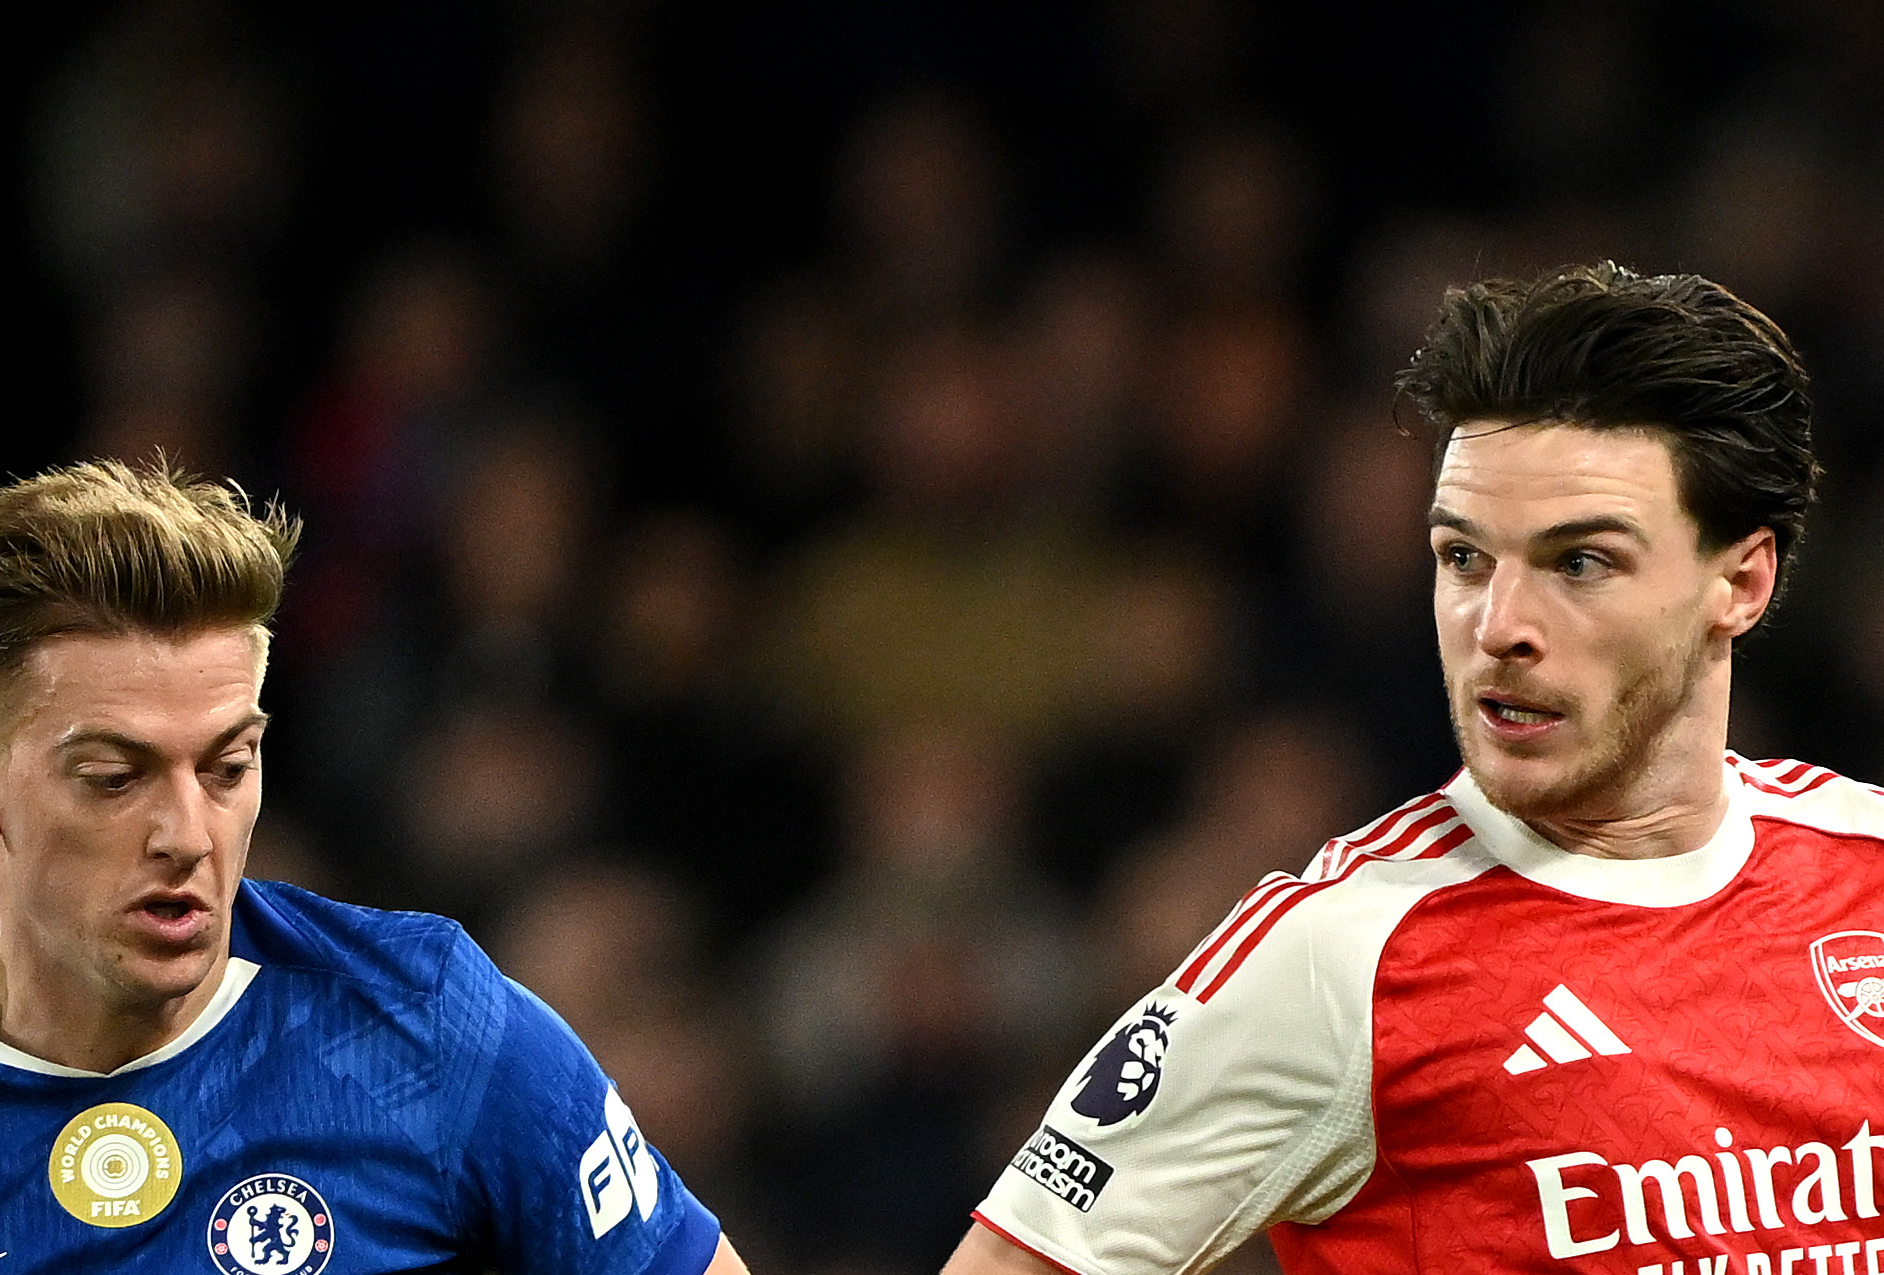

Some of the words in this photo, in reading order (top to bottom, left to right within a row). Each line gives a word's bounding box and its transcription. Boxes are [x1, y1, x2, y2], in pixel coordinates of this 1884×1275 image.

[60, 1125, 92, 1184] WORLD
[94, 1114, 171, 1179] CHAMPIONS
[230, 1179, 308, 1206] CHELSEA
[91, 1200, 140, 1217] FIFA
